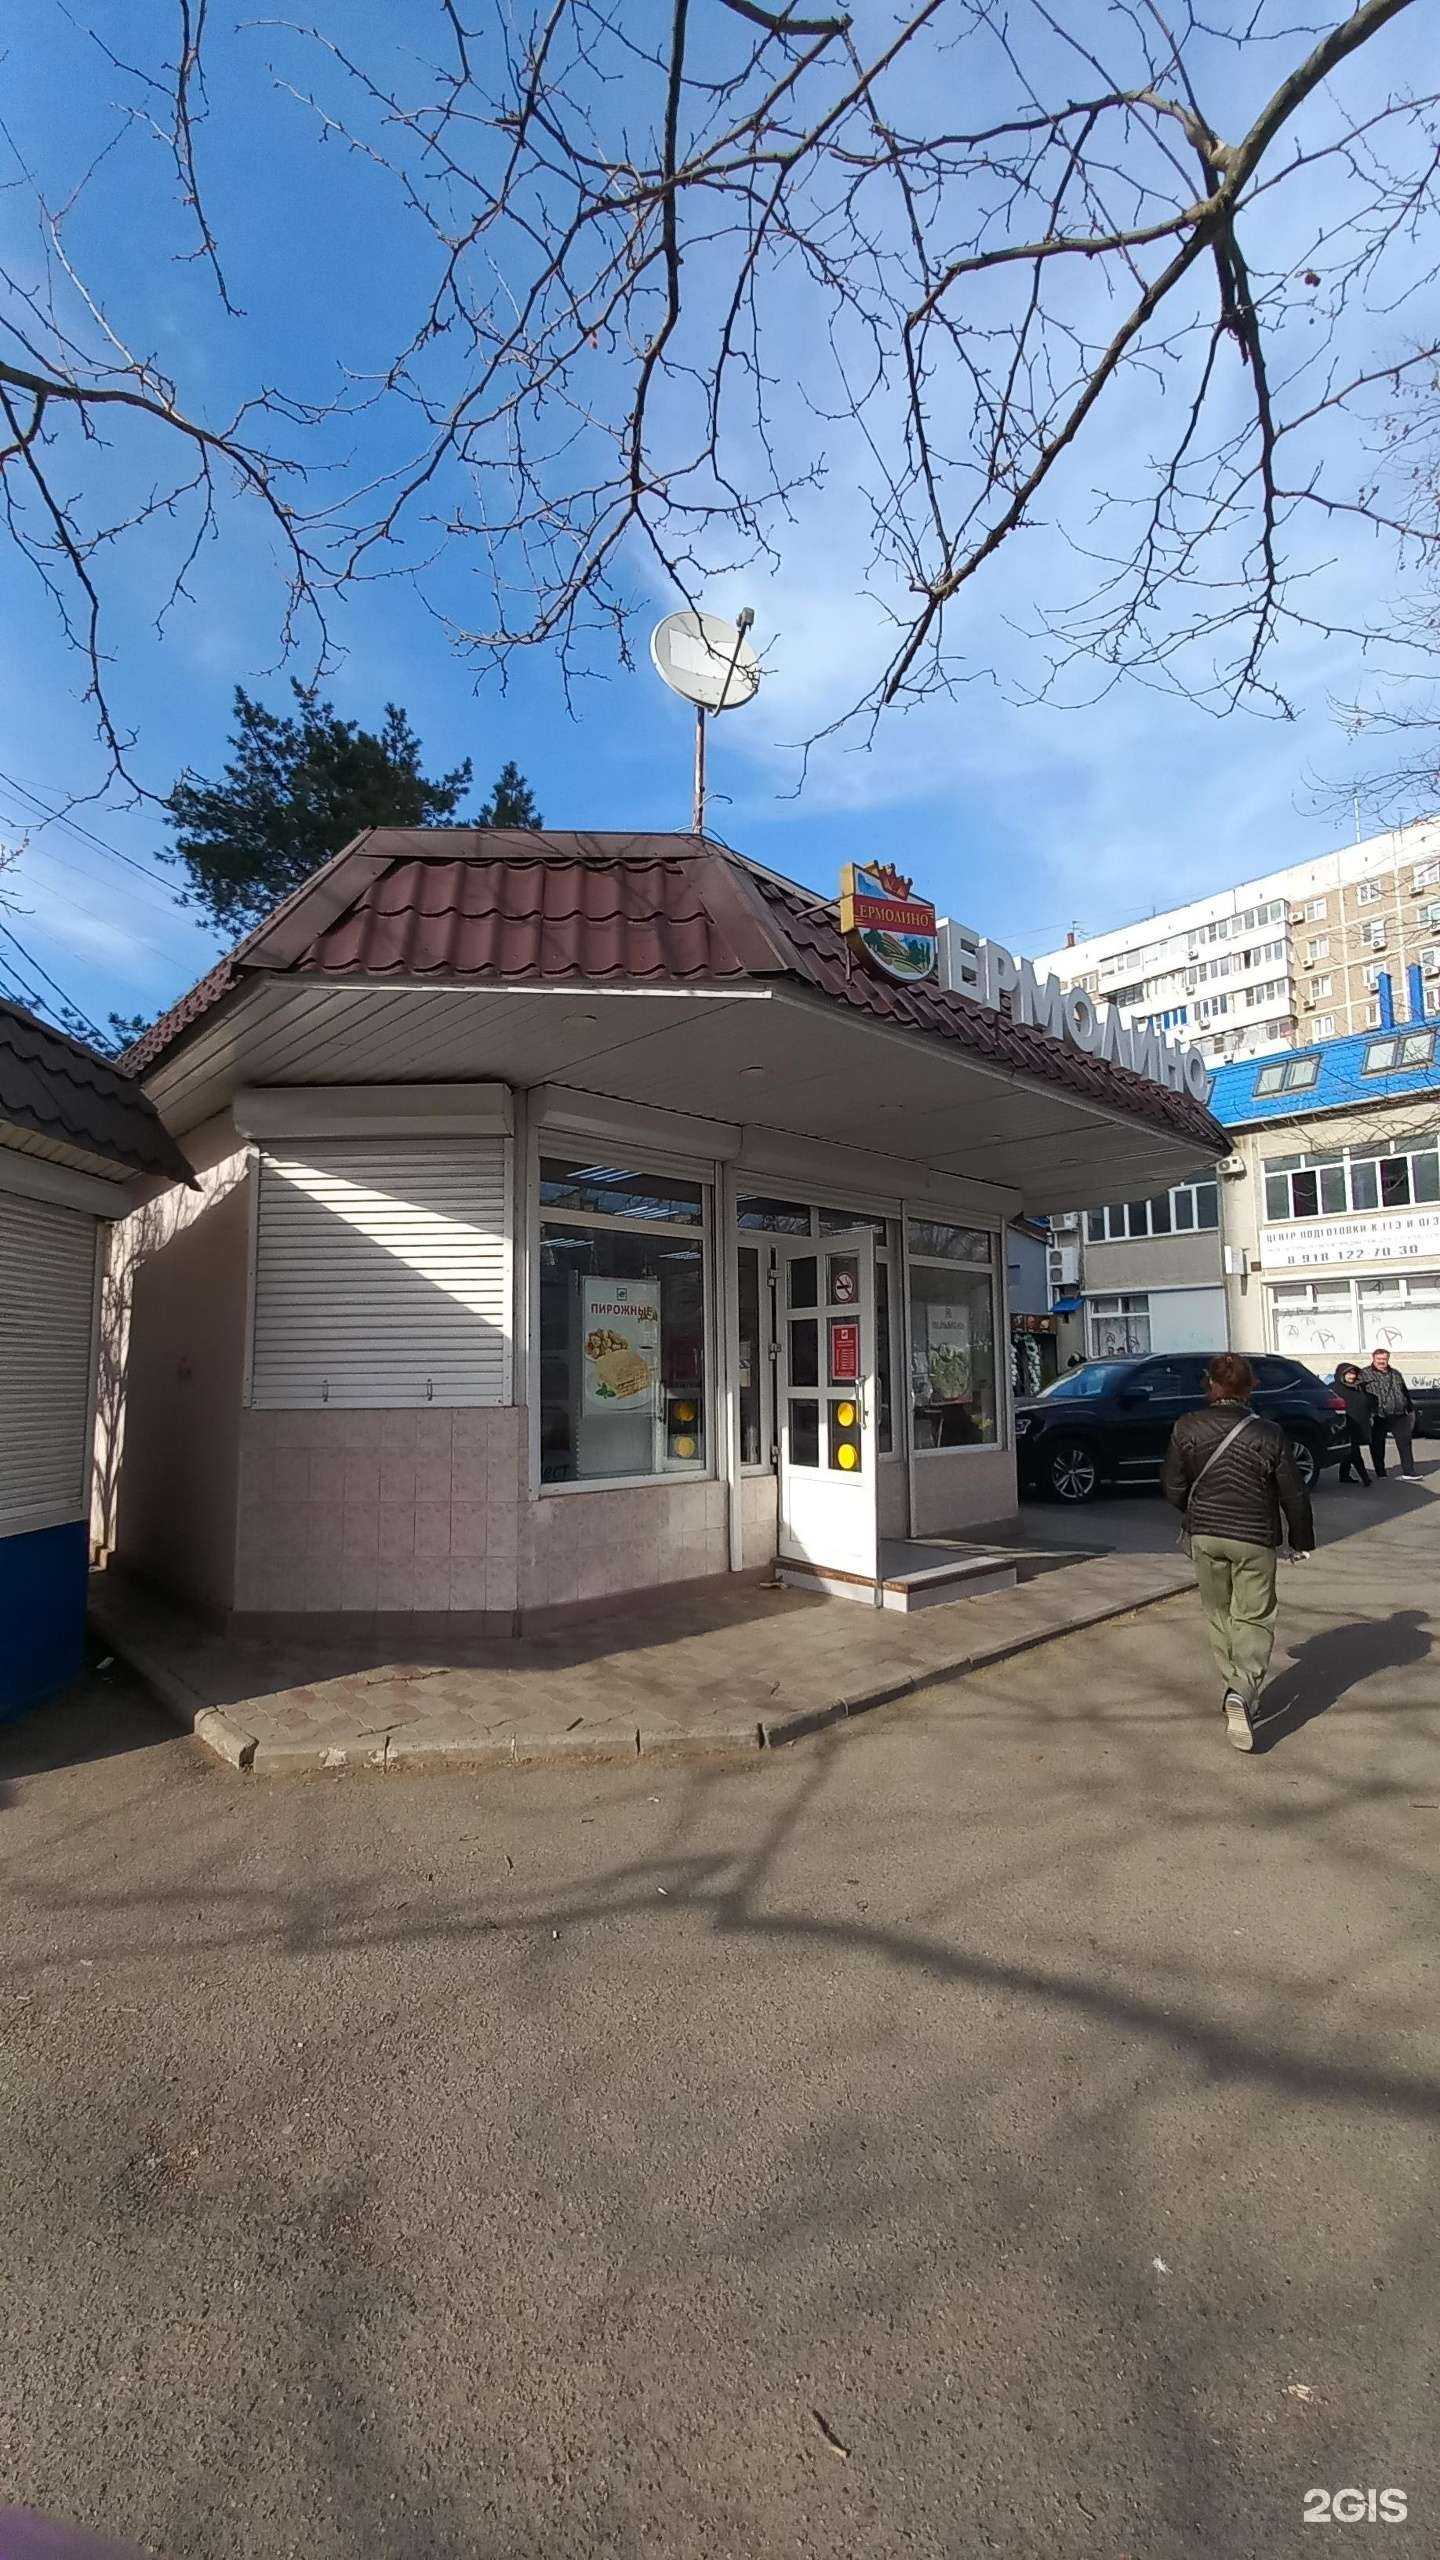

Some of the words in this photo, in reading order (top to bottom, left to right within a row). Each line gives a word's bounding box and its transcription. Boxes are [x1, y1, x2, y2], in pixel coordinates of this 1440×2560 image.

[859, 904, 929, 927] ЕРМОЛИНО
[937, 917, 1215, 1105] ЕРМОЛИНО
[591, 1303, 653, 1317] ПИРОЖНЫЕ
